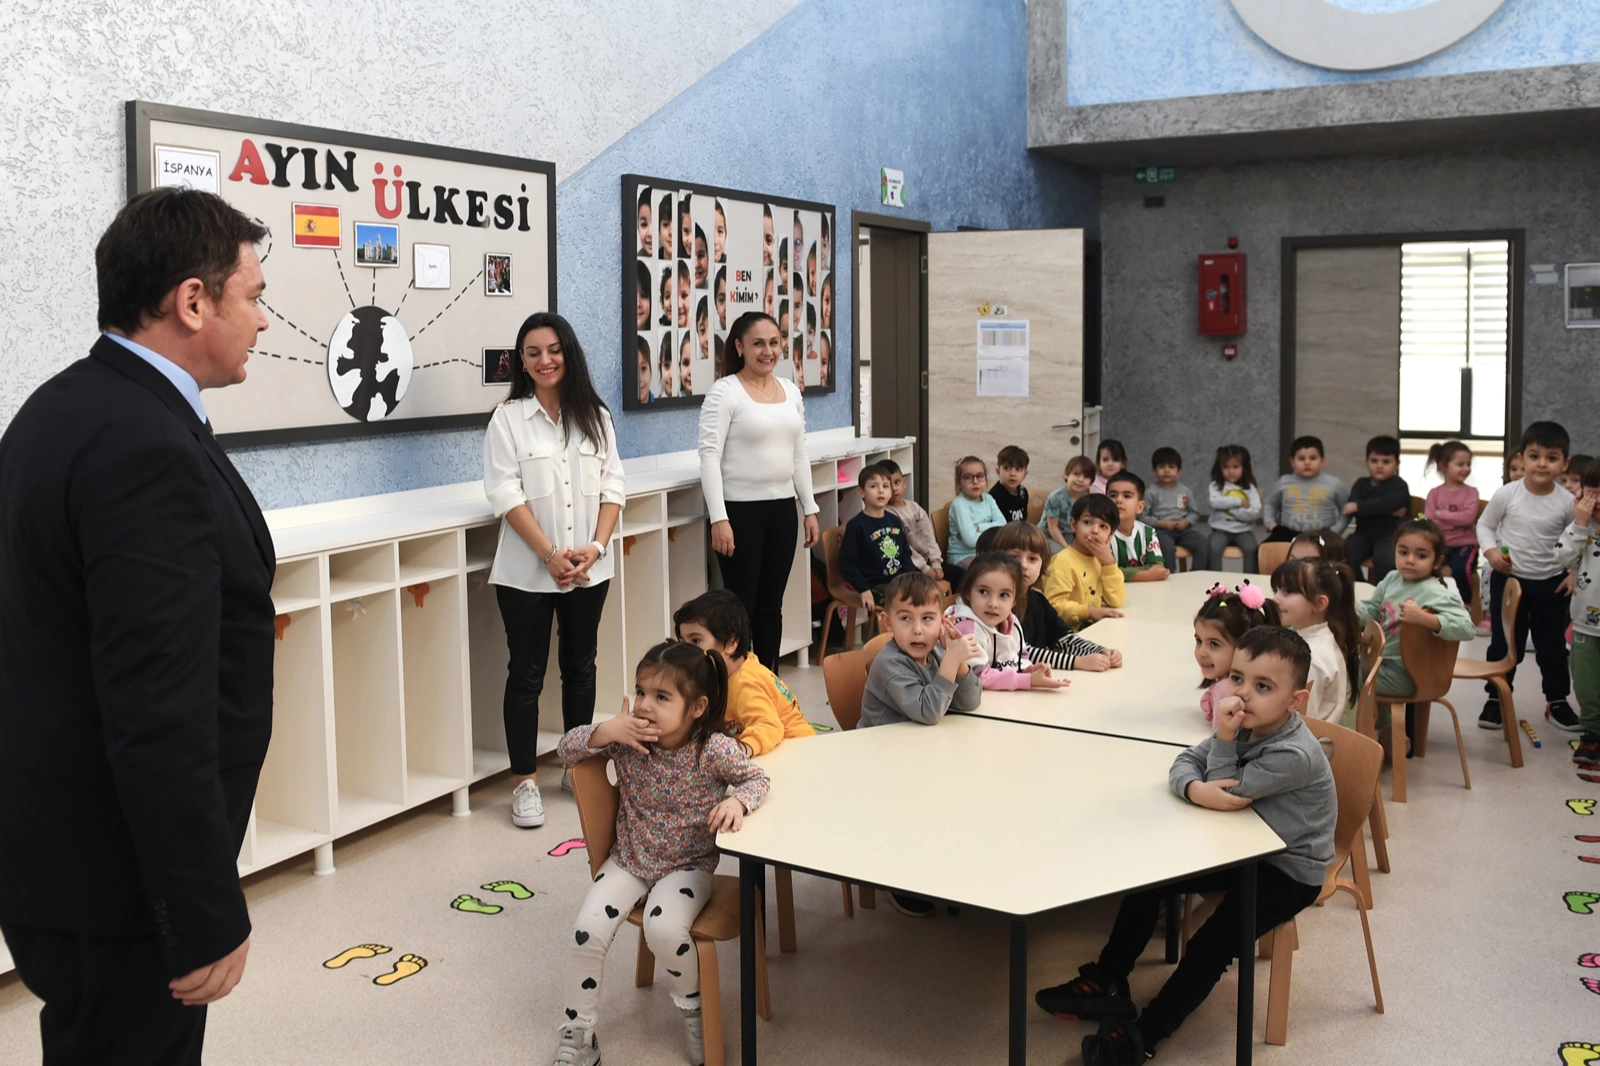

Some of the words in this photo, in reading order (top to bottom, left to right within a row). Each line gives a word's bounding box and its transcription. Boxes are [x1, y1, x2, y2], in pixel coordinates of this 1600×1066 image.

[163, 159, 213, 177] İSPANYA
[228, 138, 359, 192] AYIN
[372, 162, 531, 232] ÜLKESİ
[735, 270, 752, 282] BEN
[1285, 484, 1330, 506] PLAY
